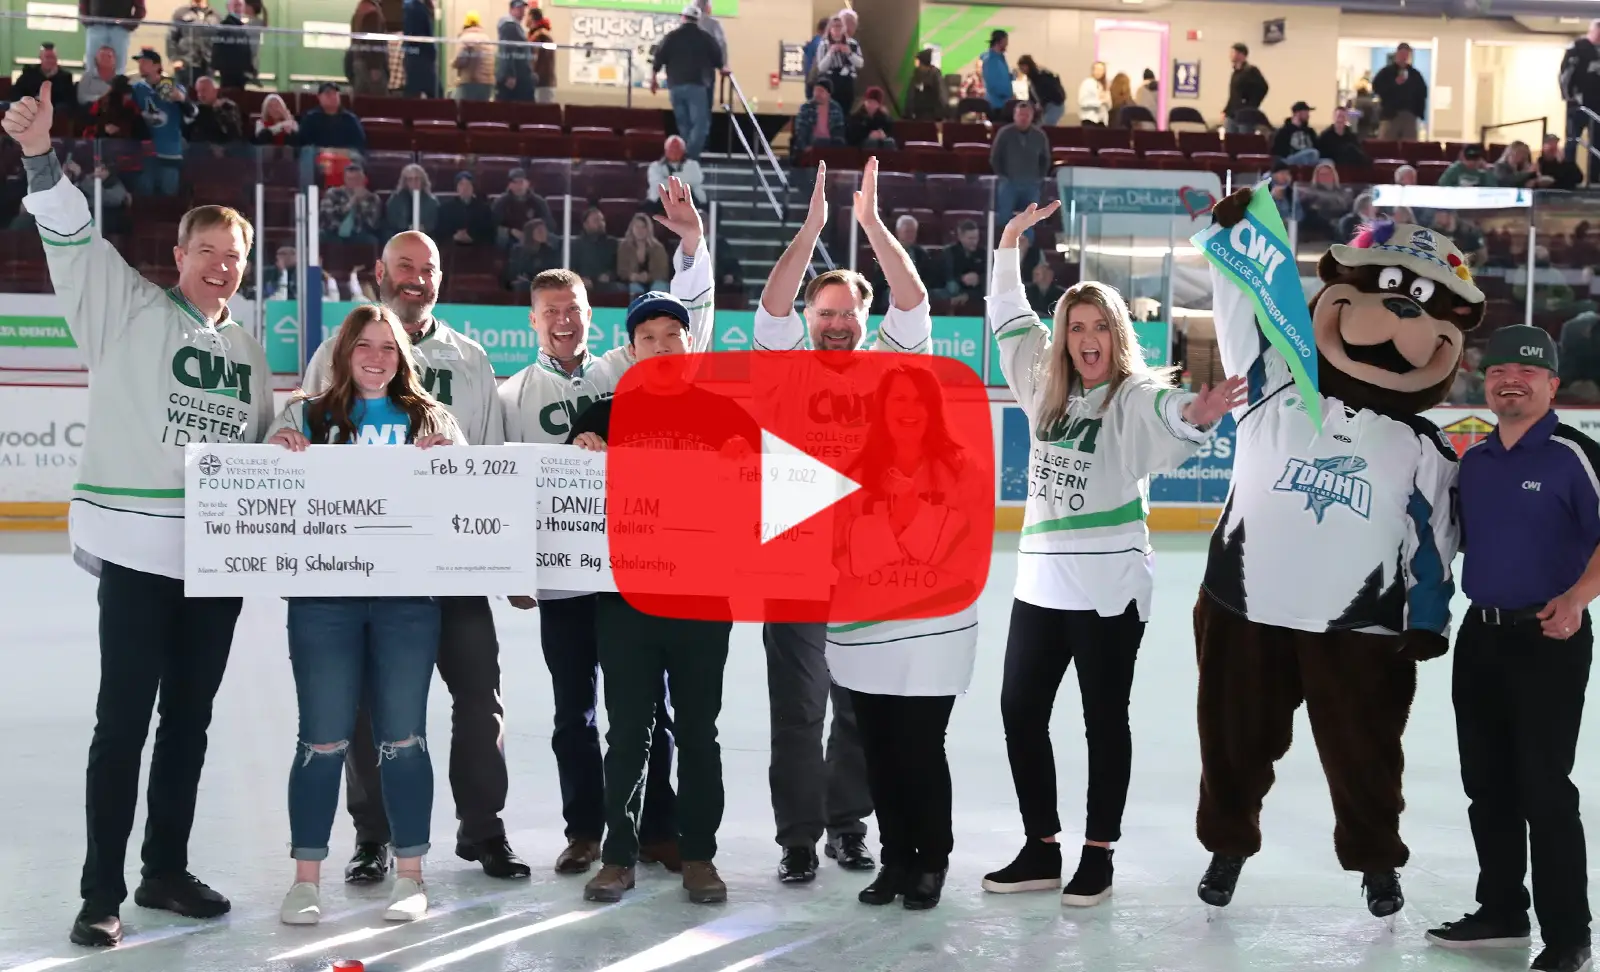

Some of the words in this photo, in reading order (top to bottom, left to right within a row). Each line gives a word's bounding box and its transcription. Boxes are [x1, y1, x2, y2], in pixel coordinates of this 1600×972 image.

[573, 16, 681, 40] CHUCK-A-P
[1229, 218, 1286, 286] CWI
[1211, 242, 1254, 280] COLLEGE
[1251, 276, 1263, 288] OF
[1260, 284, 1287, 326] WESTERN
[1284, 324, 1312, 358] IDAHO
[19, 326, 67, 338] DENTAL
[931, 331, 976, 357] mie
[1519, 345, 1544, 358] CWI
[172, 346, 252, 405] CWI
[169, 393, 235, 419] COLLEGE
[162, 425, 230, 447] IDA
[805, 430, 862, 444] COLLEGE
[225, 457, 268, 465] COLLEGE
[271, 457, 281, 465] of
[430, 458, 458, 475] Feb
[465, 458, 477, 476] 9,
[482, 459, 519, 475] 2022
[540, 456, 581, 466] COLLEGE
[583, 459, 592, 467] of
[1034, 448, 1070, 468] OLLEGE
[1073, 459, 1092, 472] OF
[226, 467, 270, 476] WESTERN
[274, 467, 305, 476] IDAHO
[540, 466, 581, 476] WESTERN
[585, 468, 609, 477] IDAH
[739, 465, 763, 483] Feb
[787, 468, 817, 484] 2022
[199, 478, 305, 490] FOUNDATION
[536, 477, 615, 491] UNDATION
[1273, 458, 1372, 518] IDAHO
[1521, 480, 1542, 492] CWI
[1028, 480, 1084, 511] DAHO
[237, 498, 297, 516] SYDNEY
[307, 498, 388, 516] SHOEMAKE
[552, 495, 613, 515] DANIEL
[623, 497, 660, 518] LAM
[204, 520, 231, 534] Two
[236, 519, 296, 535] thousand
[303, 521, 347, 535] dollars
[545, 516, 606, 534] thousand
[613, 520, 655, 535] dollars
[224, 556, 268, 573] SCORE
[275, 552, 298, 577] Big
[305, 553, 375, 577] Scholarship
[536, 552, 571, 567] SCORE
[580, 553, 601, 572] Big
[608, 552, 677, 577] Scholarship
[867, 570, 938, 588] DAHO
